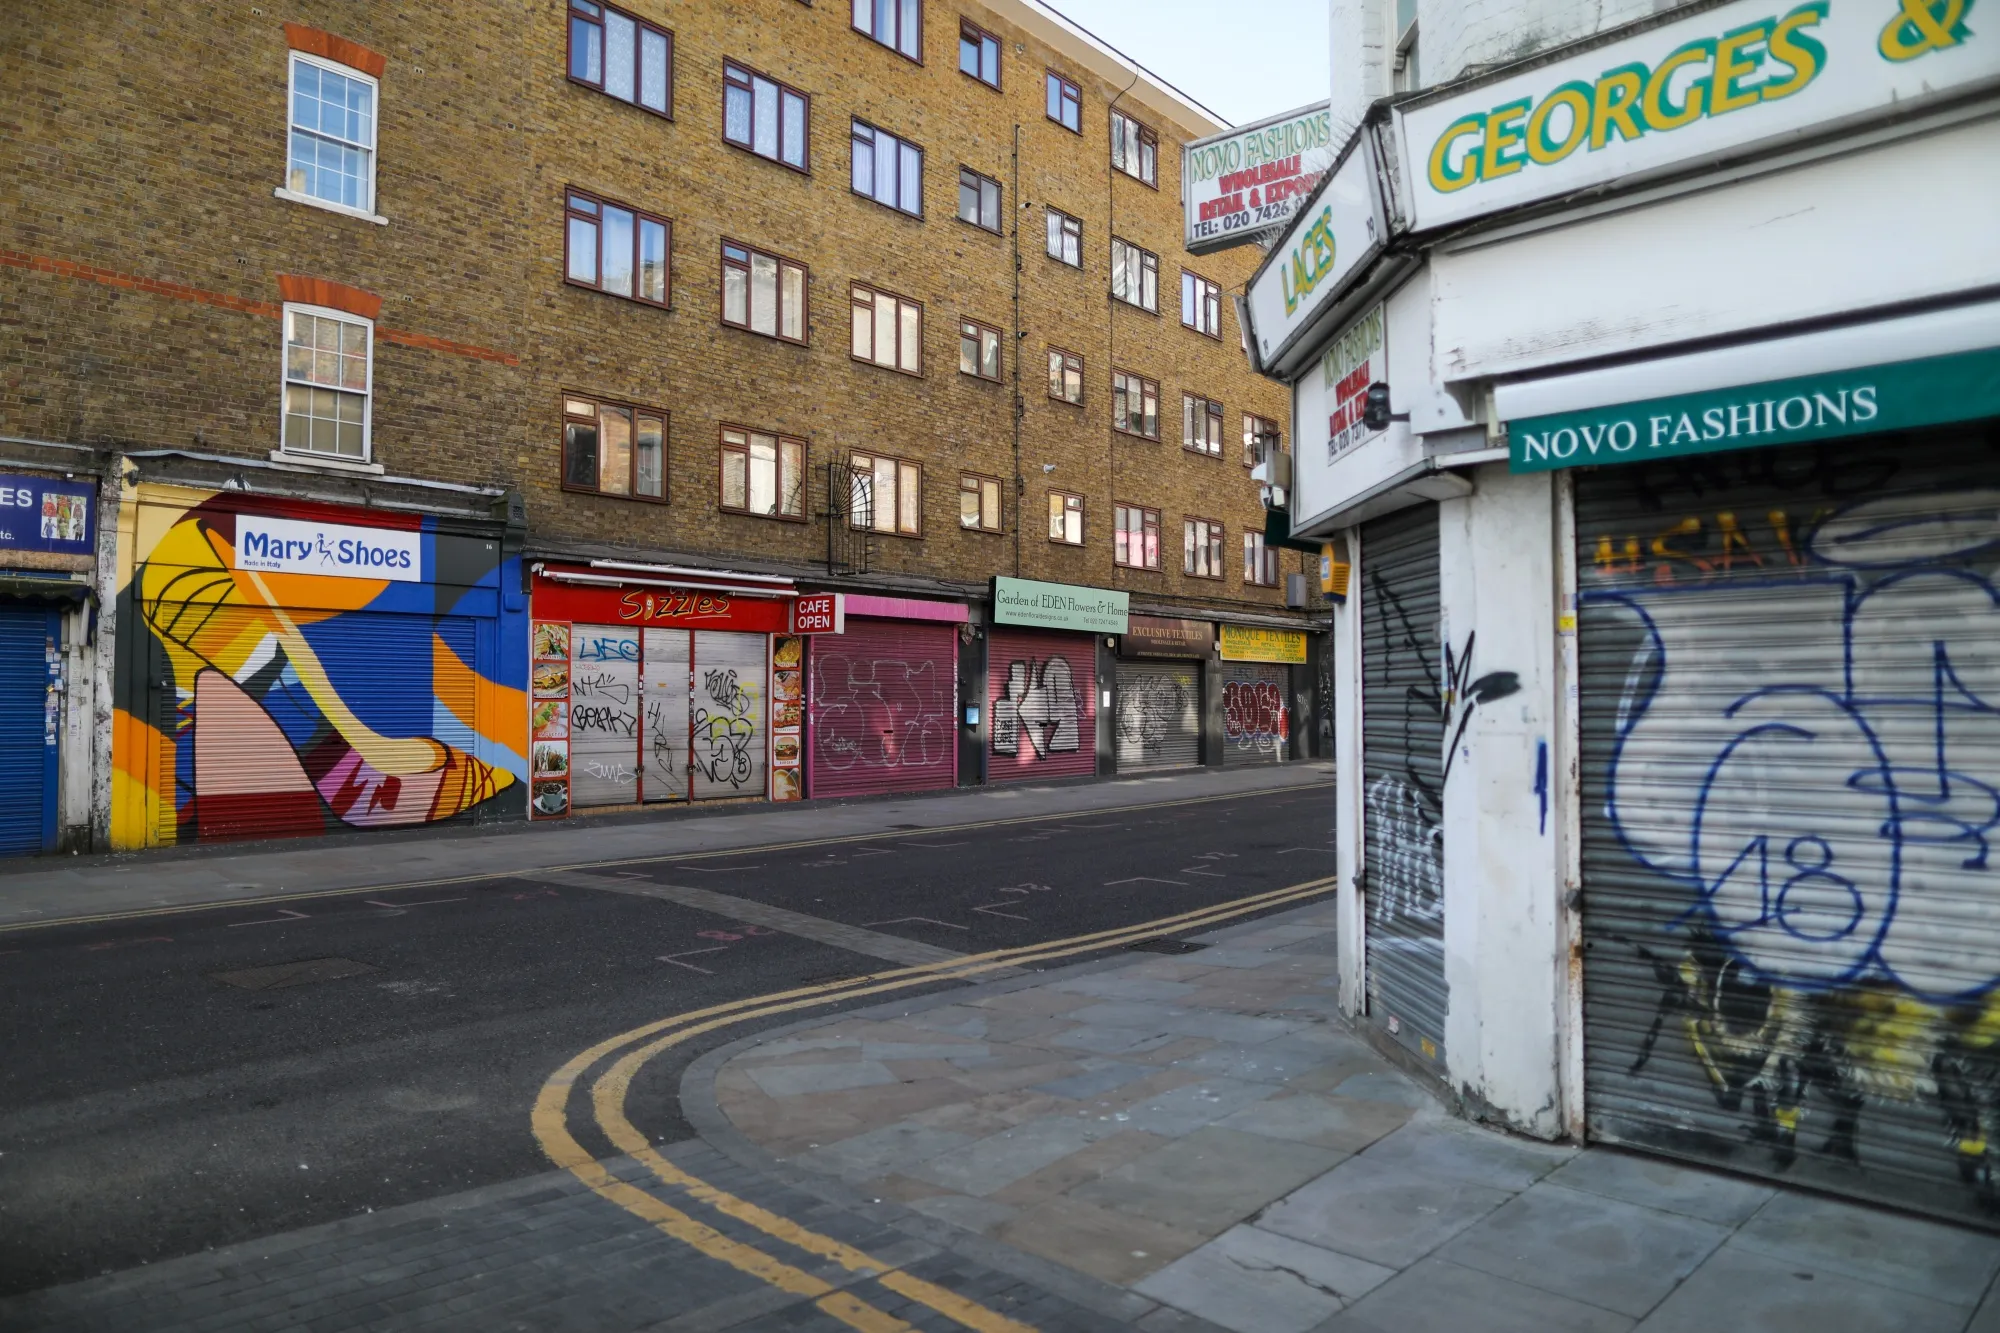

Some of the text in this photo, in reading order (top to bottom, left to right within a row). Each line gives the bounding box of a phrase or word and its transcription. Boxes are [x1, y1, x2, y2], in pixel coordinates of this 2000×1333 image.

[1428, 0, 1977, 193] GEORGES &
[1192, 111, 1330, 184] NOVO FASHIONS
[1219, 154, 1302, 195] WHOLESALE
[1194, 221, 1219, 238] TEL:
[1223, 211, 1250, 230] 020
[1256, 201, 1290, 223] 7426
[1199, 192, 1245, 222] RETAIL
[1249, 188, 1262, 208] &
[1366, 215, 1376, 241] 19
[1281, 204, 1336, 319] LACES
[1522, 386, 1879, 462] NOVO FASHIONS
[244, 531, 411, 569] Mary Shoes
[244, 559, 259, 567] Made
[266, 560, 281, 569] Italy
[799, 600, 830, 613] CAFE
[997, 589, 1128, 617] Garden of EDEN Flowers & Home
[797, 615, 830, 629] OPEN
[1132, 626, 1203, 640] EXCLUSIVE TEXTILES
[1224, 625, 1260, 641] MONIQUE
[1265, 630, 1301, 644] TEXTILES
